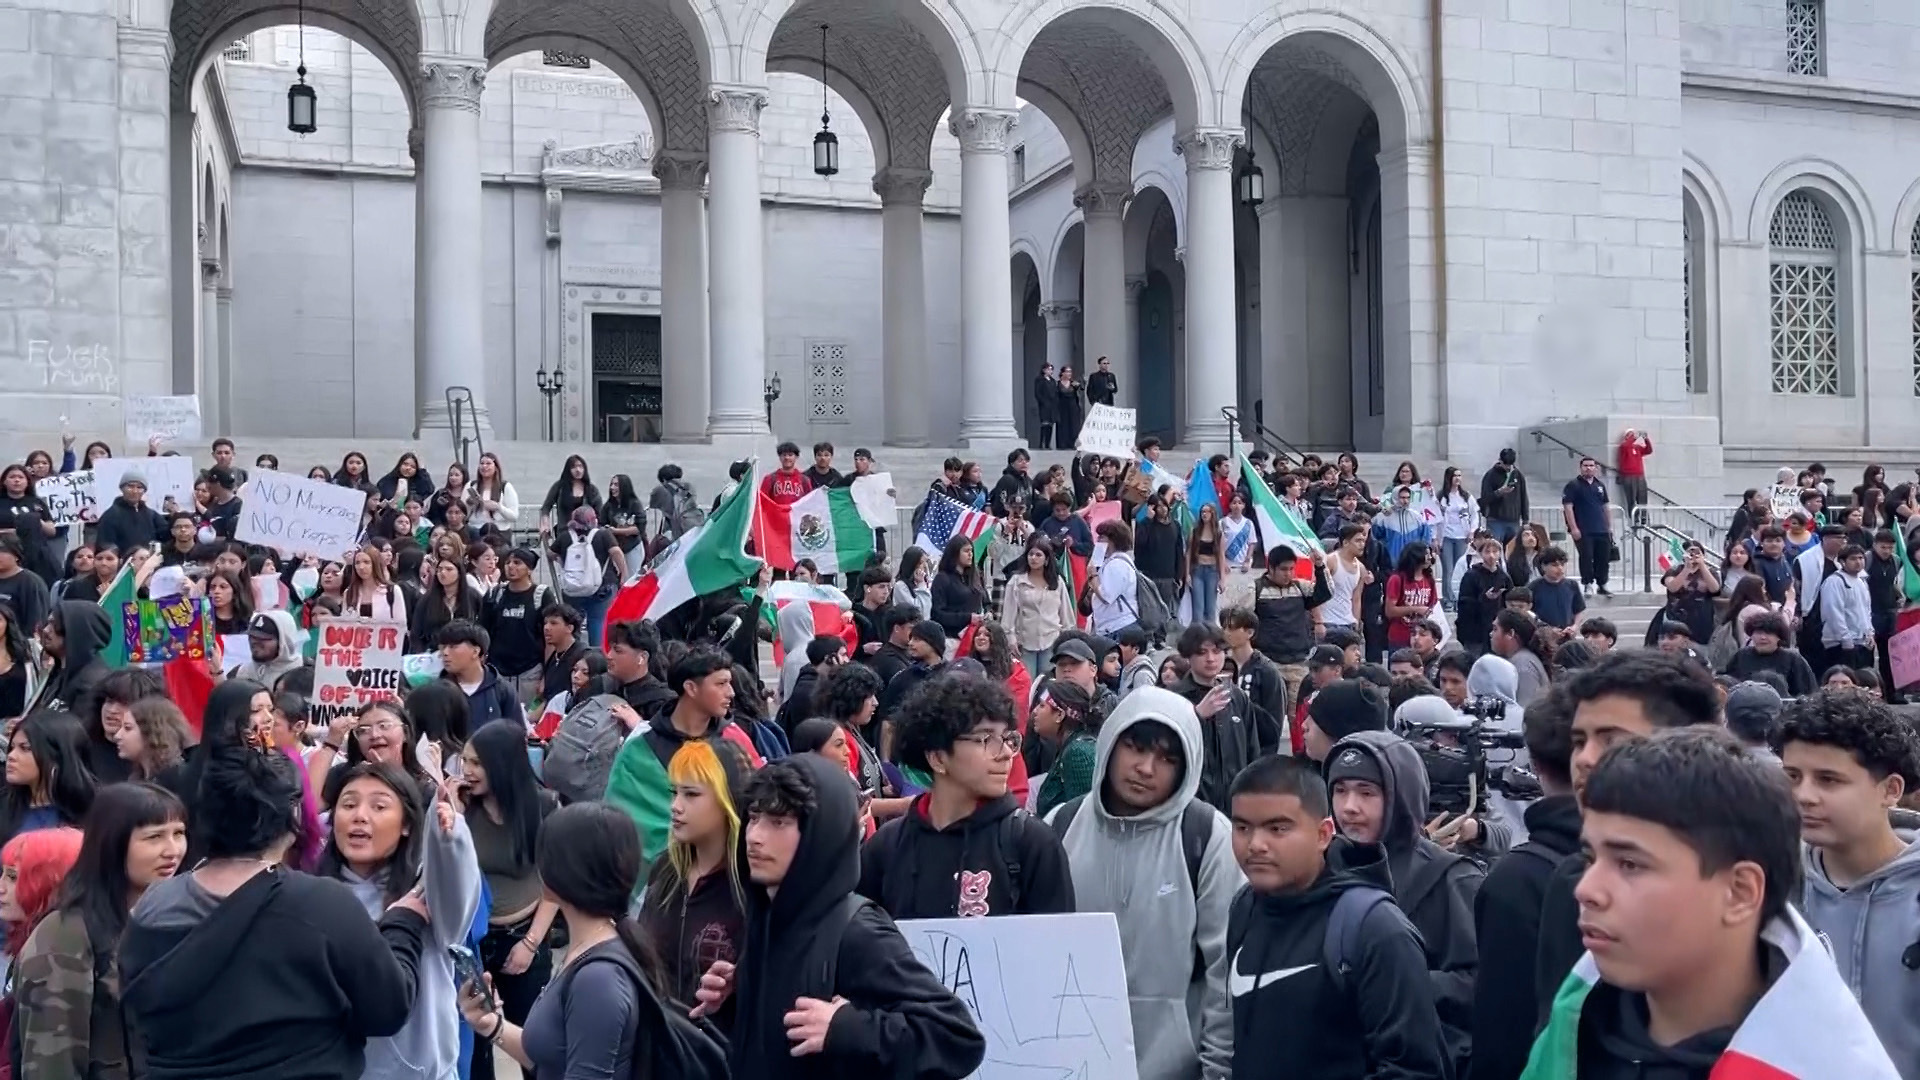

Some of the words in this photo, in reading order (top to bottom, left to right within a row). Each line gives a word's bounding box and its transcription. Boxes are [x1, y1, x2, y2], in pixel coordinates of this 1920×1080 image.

[255, 480, 292, 505] NO
[251, 512, 283, 535] NO
[319, 648, 362, 667] THE
[346, 668, 398, 689] VOICE
[320, 684, 352, 704] OF
